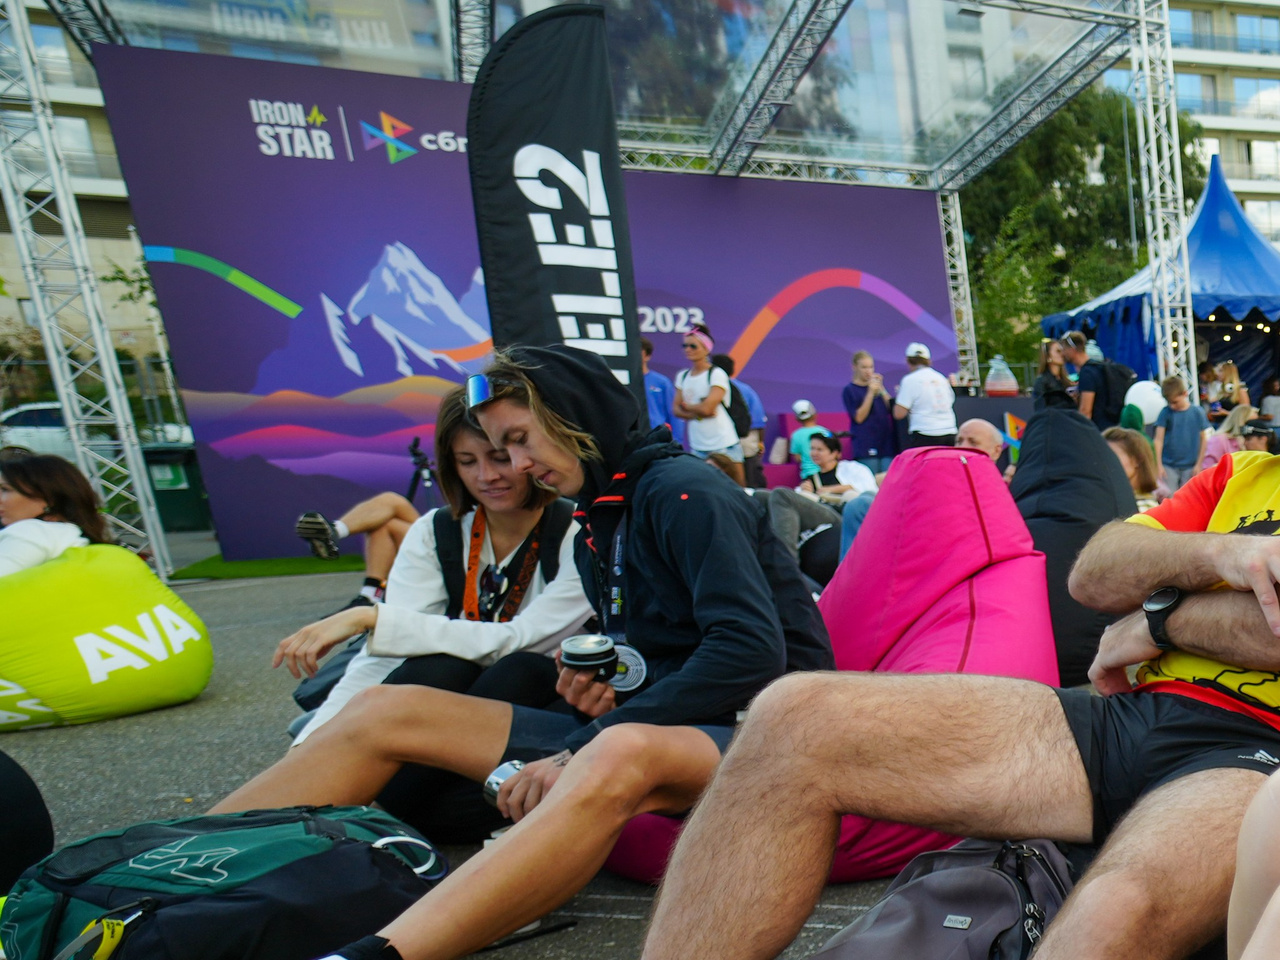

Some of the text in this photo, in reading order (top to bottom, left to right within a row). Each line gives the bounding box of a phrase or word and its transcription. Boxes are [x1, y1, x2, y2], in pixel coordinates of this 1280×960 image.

[249, 99, 307, 127] IRON
[256, 125, 335, 160] STAR
[513, 143, 631, 386] ELE2
[638, 306, 705, 334] 2023
[73, 604, 202, 685] AVA
